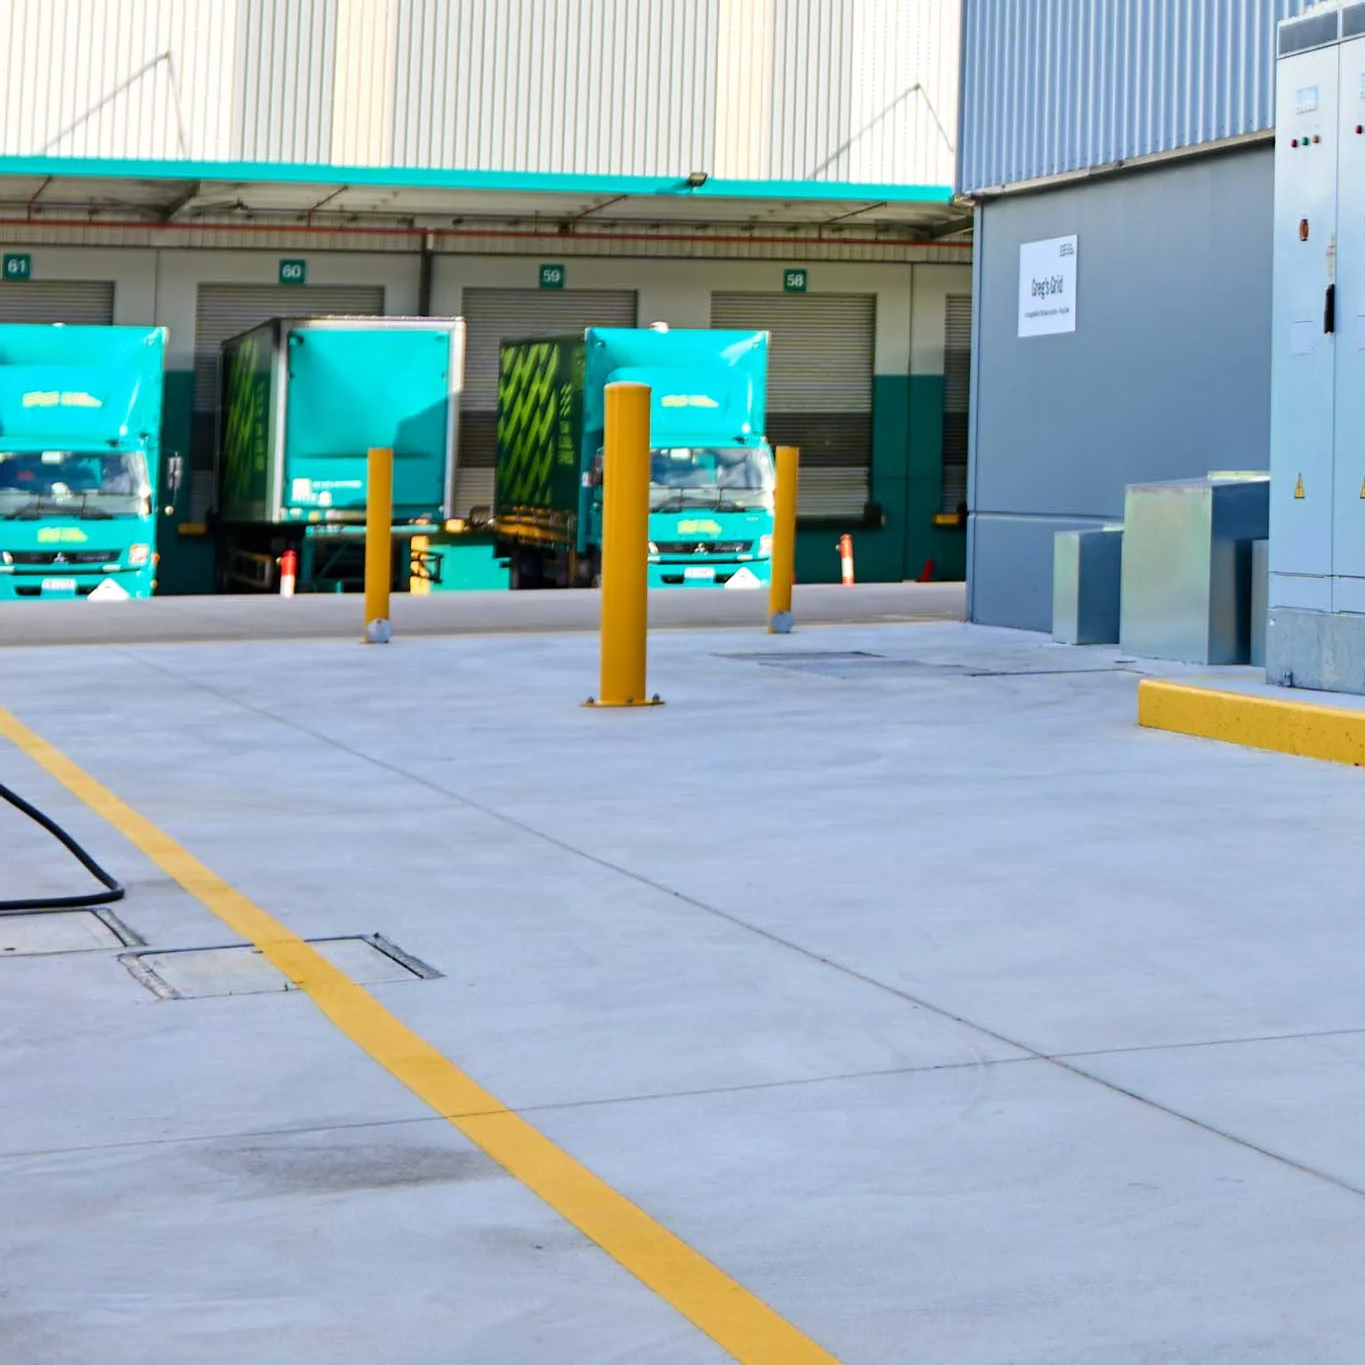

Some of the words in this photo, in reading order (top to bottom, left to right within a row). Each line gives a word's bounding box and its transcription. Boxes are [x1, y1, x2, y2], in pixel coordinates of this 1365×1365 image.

[8, 259, 25, 273] 61
[283, 265, 301, 278] 60
[543, 269, 560, 282] 59
[787, 274, 803, 286] 58
